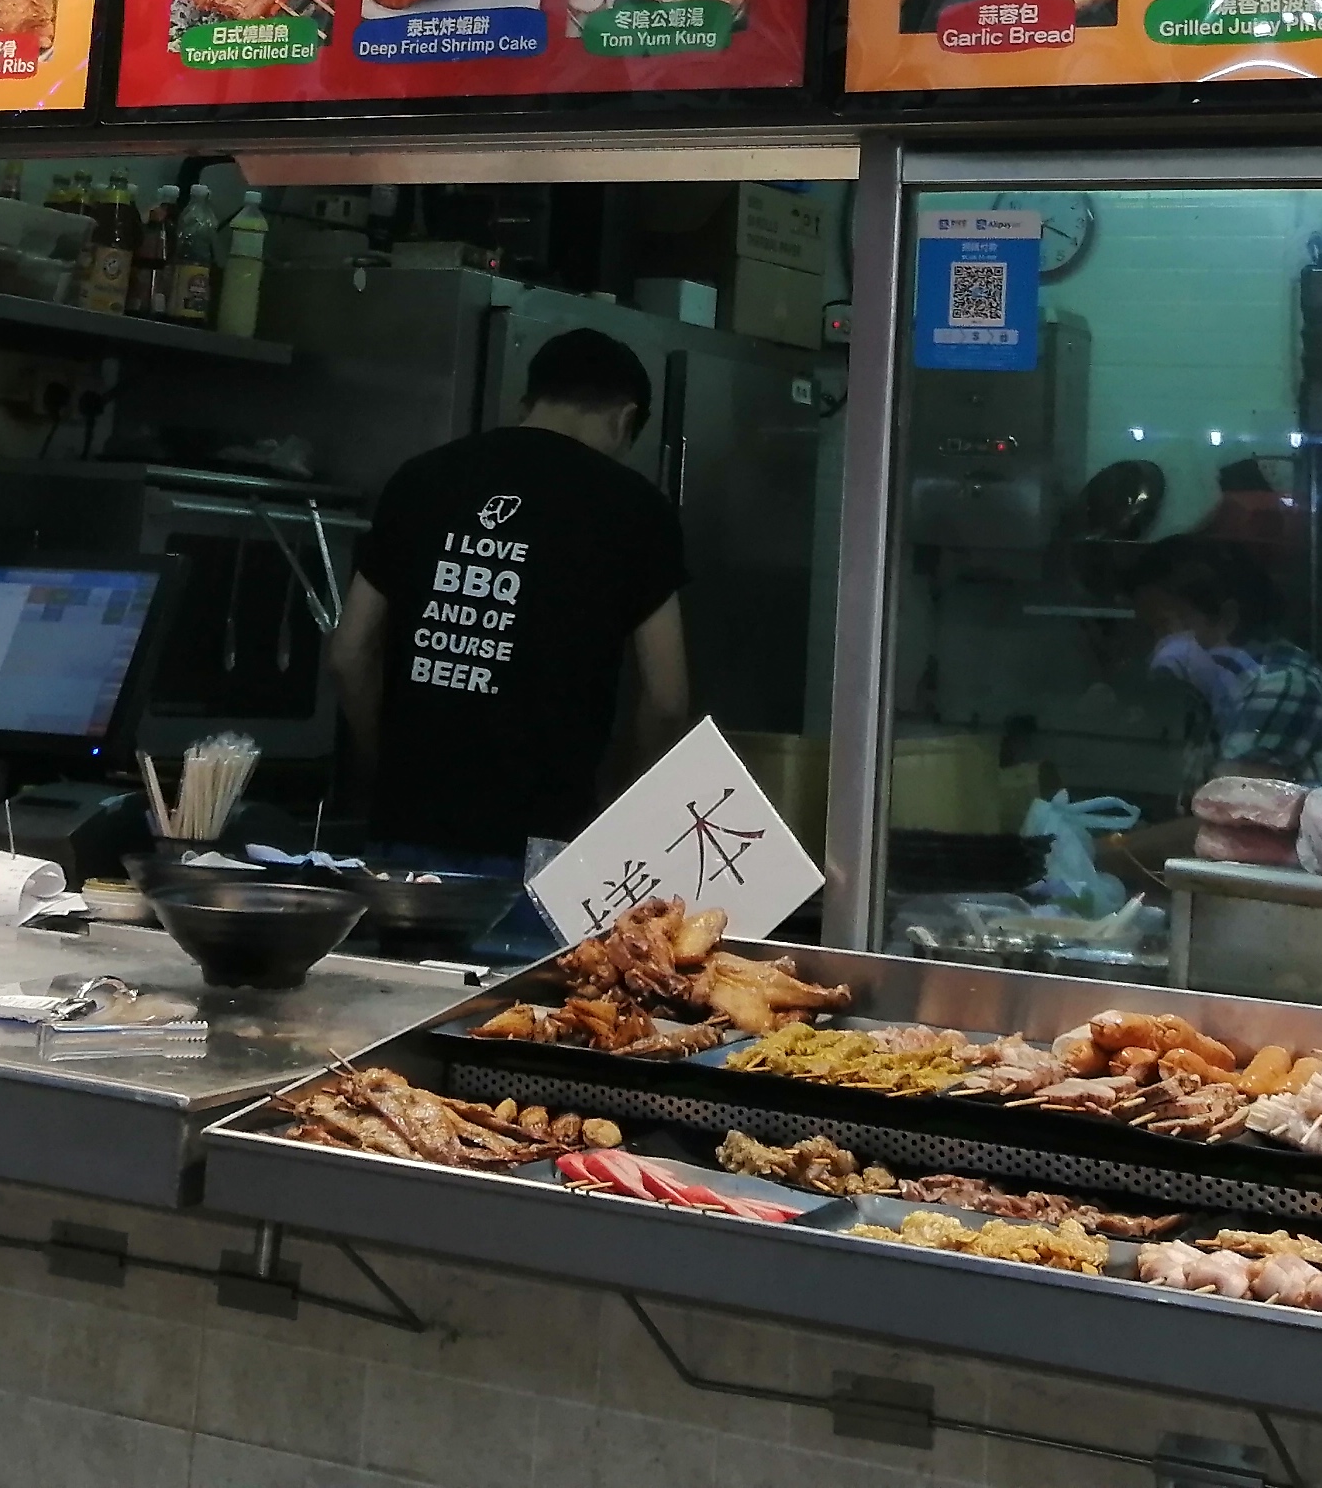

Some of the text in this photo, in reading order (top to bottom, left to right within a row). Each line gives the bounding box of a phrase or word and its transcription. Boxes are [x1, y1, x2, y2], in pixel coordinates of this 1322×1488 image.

[978, 3, 1040, 25] 蒜蓉包
[600, 29, 717, 48] Tom Yum Kung
[942, 24, 1075, 48] Garlic Bread
[1159, 17, 1224, 38] Grilled
[185, 43, 314, 64] Teriyaki Grilled Eel
[359, 36, 538, 60] Deep Fried Shrimp Cake
[3, 58, 35, 74] Ribs
[444, 532, 529, 563] I LOVE
[432, 559, 521, 606] BBQ
[422, 600, 516, 631] AND OF
[414, 627, 514, 662] COURSE
[410, 655, 499, 695] BEER.
